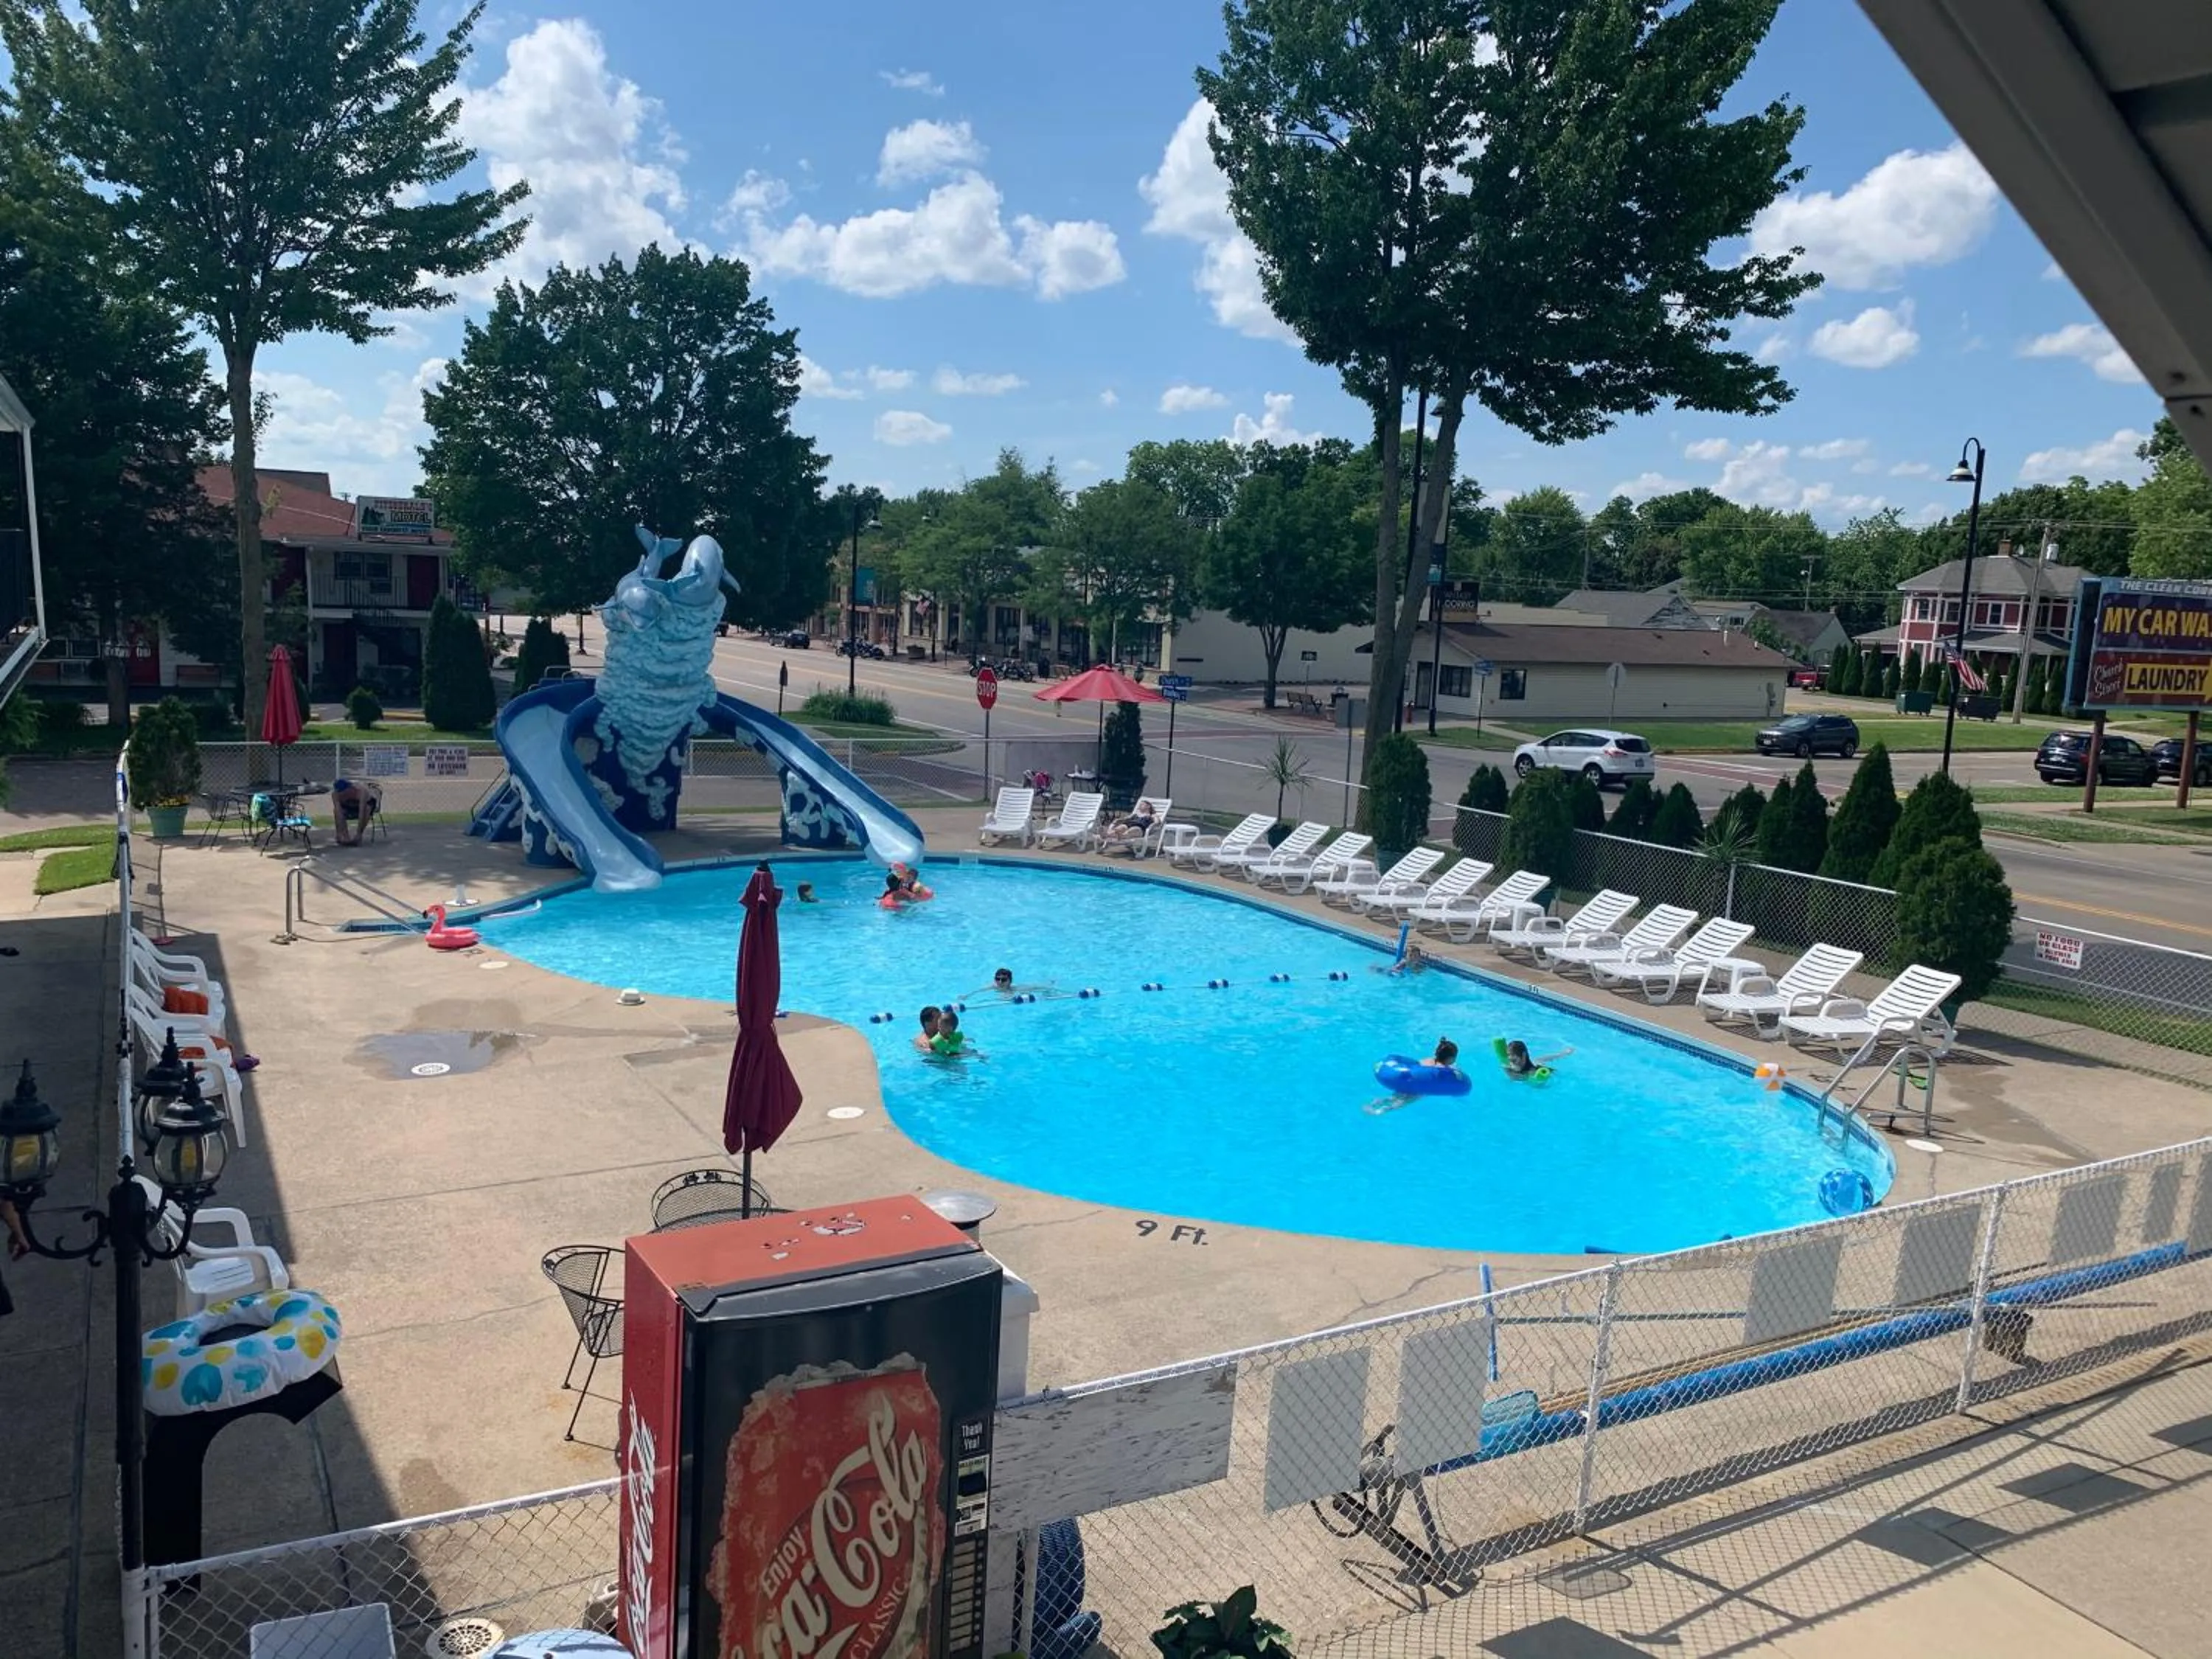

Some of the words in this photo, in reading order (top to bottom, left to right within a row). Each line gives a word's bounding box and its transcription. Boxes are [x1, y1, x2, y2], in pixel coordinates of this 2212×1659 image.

[2121, 580, 2142, 591] THE
[2145, 582, 2183, 593] CLEAN
[2104, 607, 2137, 634] MY
[2139, 609, 2177, 636] CAR
[2181, 611, 2212, 638] WA
[2126, 668, 2208, 692] LAUNDRY
[978, 681, 996, 698] STOP
[2039, 933, 2052, 942] NO
[2055, 936, 2080, 947] FOOD
[2052, 943, 2079, 953] GLASS
[1135, 1220, 1158, 1237] 9
[1170, 1225, 1208, 1245] Ft.
[961, 1421, 983, 1438] Thank
[849, 1576, 909, 1659] CLASSIC
